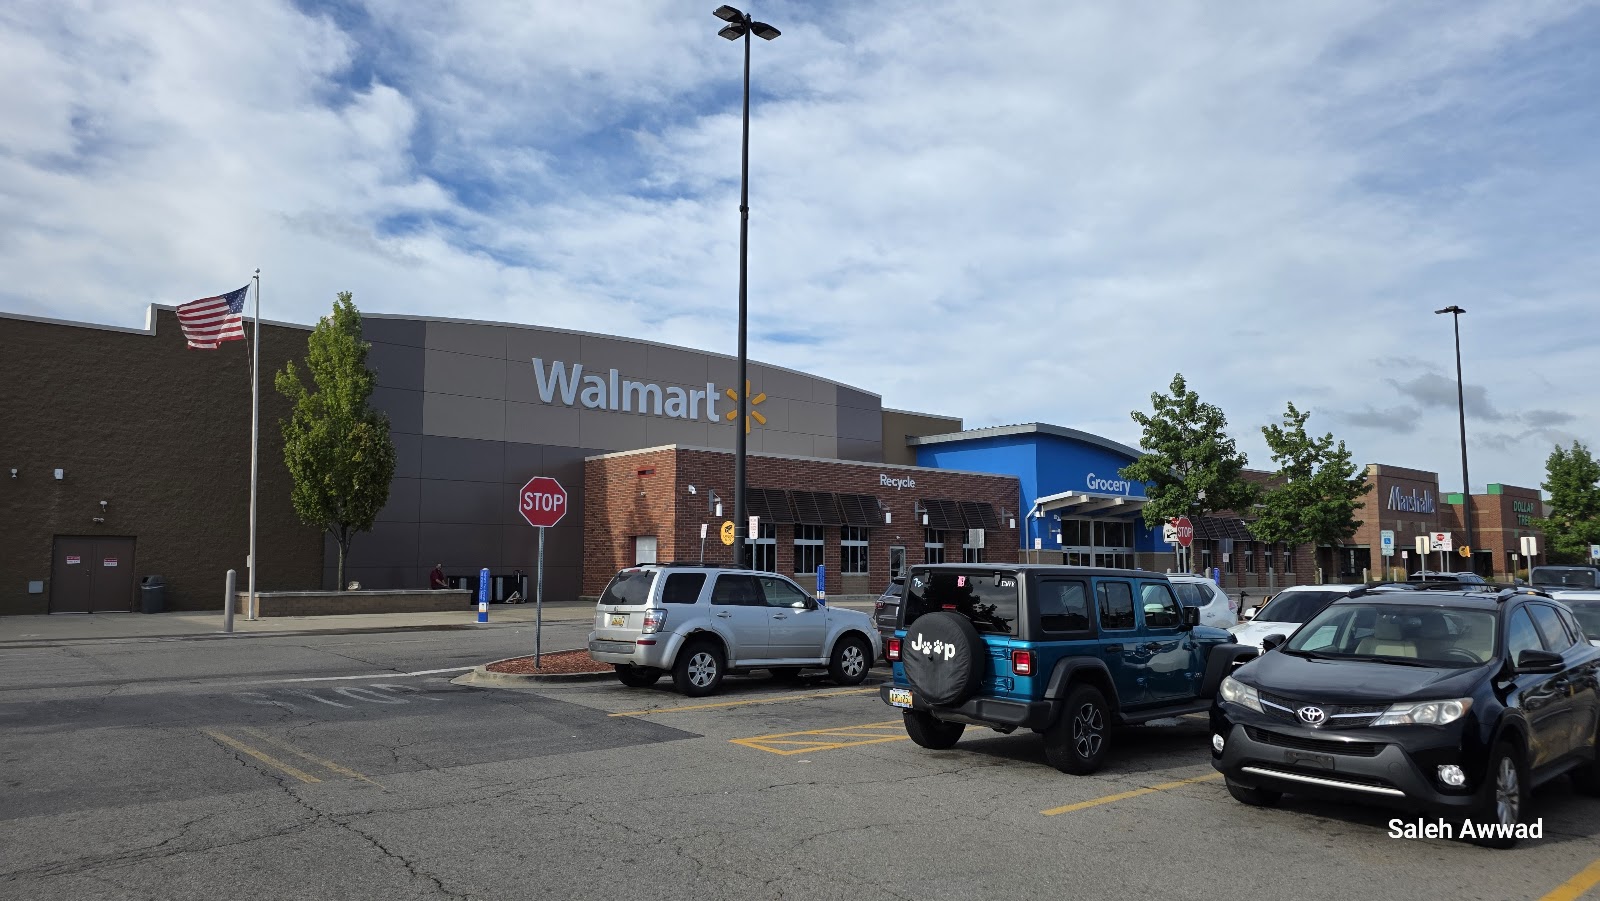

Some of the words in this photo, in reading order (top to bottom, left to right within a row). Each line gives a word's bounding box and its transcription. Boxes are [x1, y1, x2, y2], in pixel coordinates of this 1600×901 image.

[531, 357, 720, 423] Walmart
[880, 473, 916, 491] Recycle
[1086, 472, 1131, 496] Grocery
[523, 492, 564, 512] STOP
[1387, 485, 1435, 514] Marshalls
[1177, 526, 1192, 538] STOP
